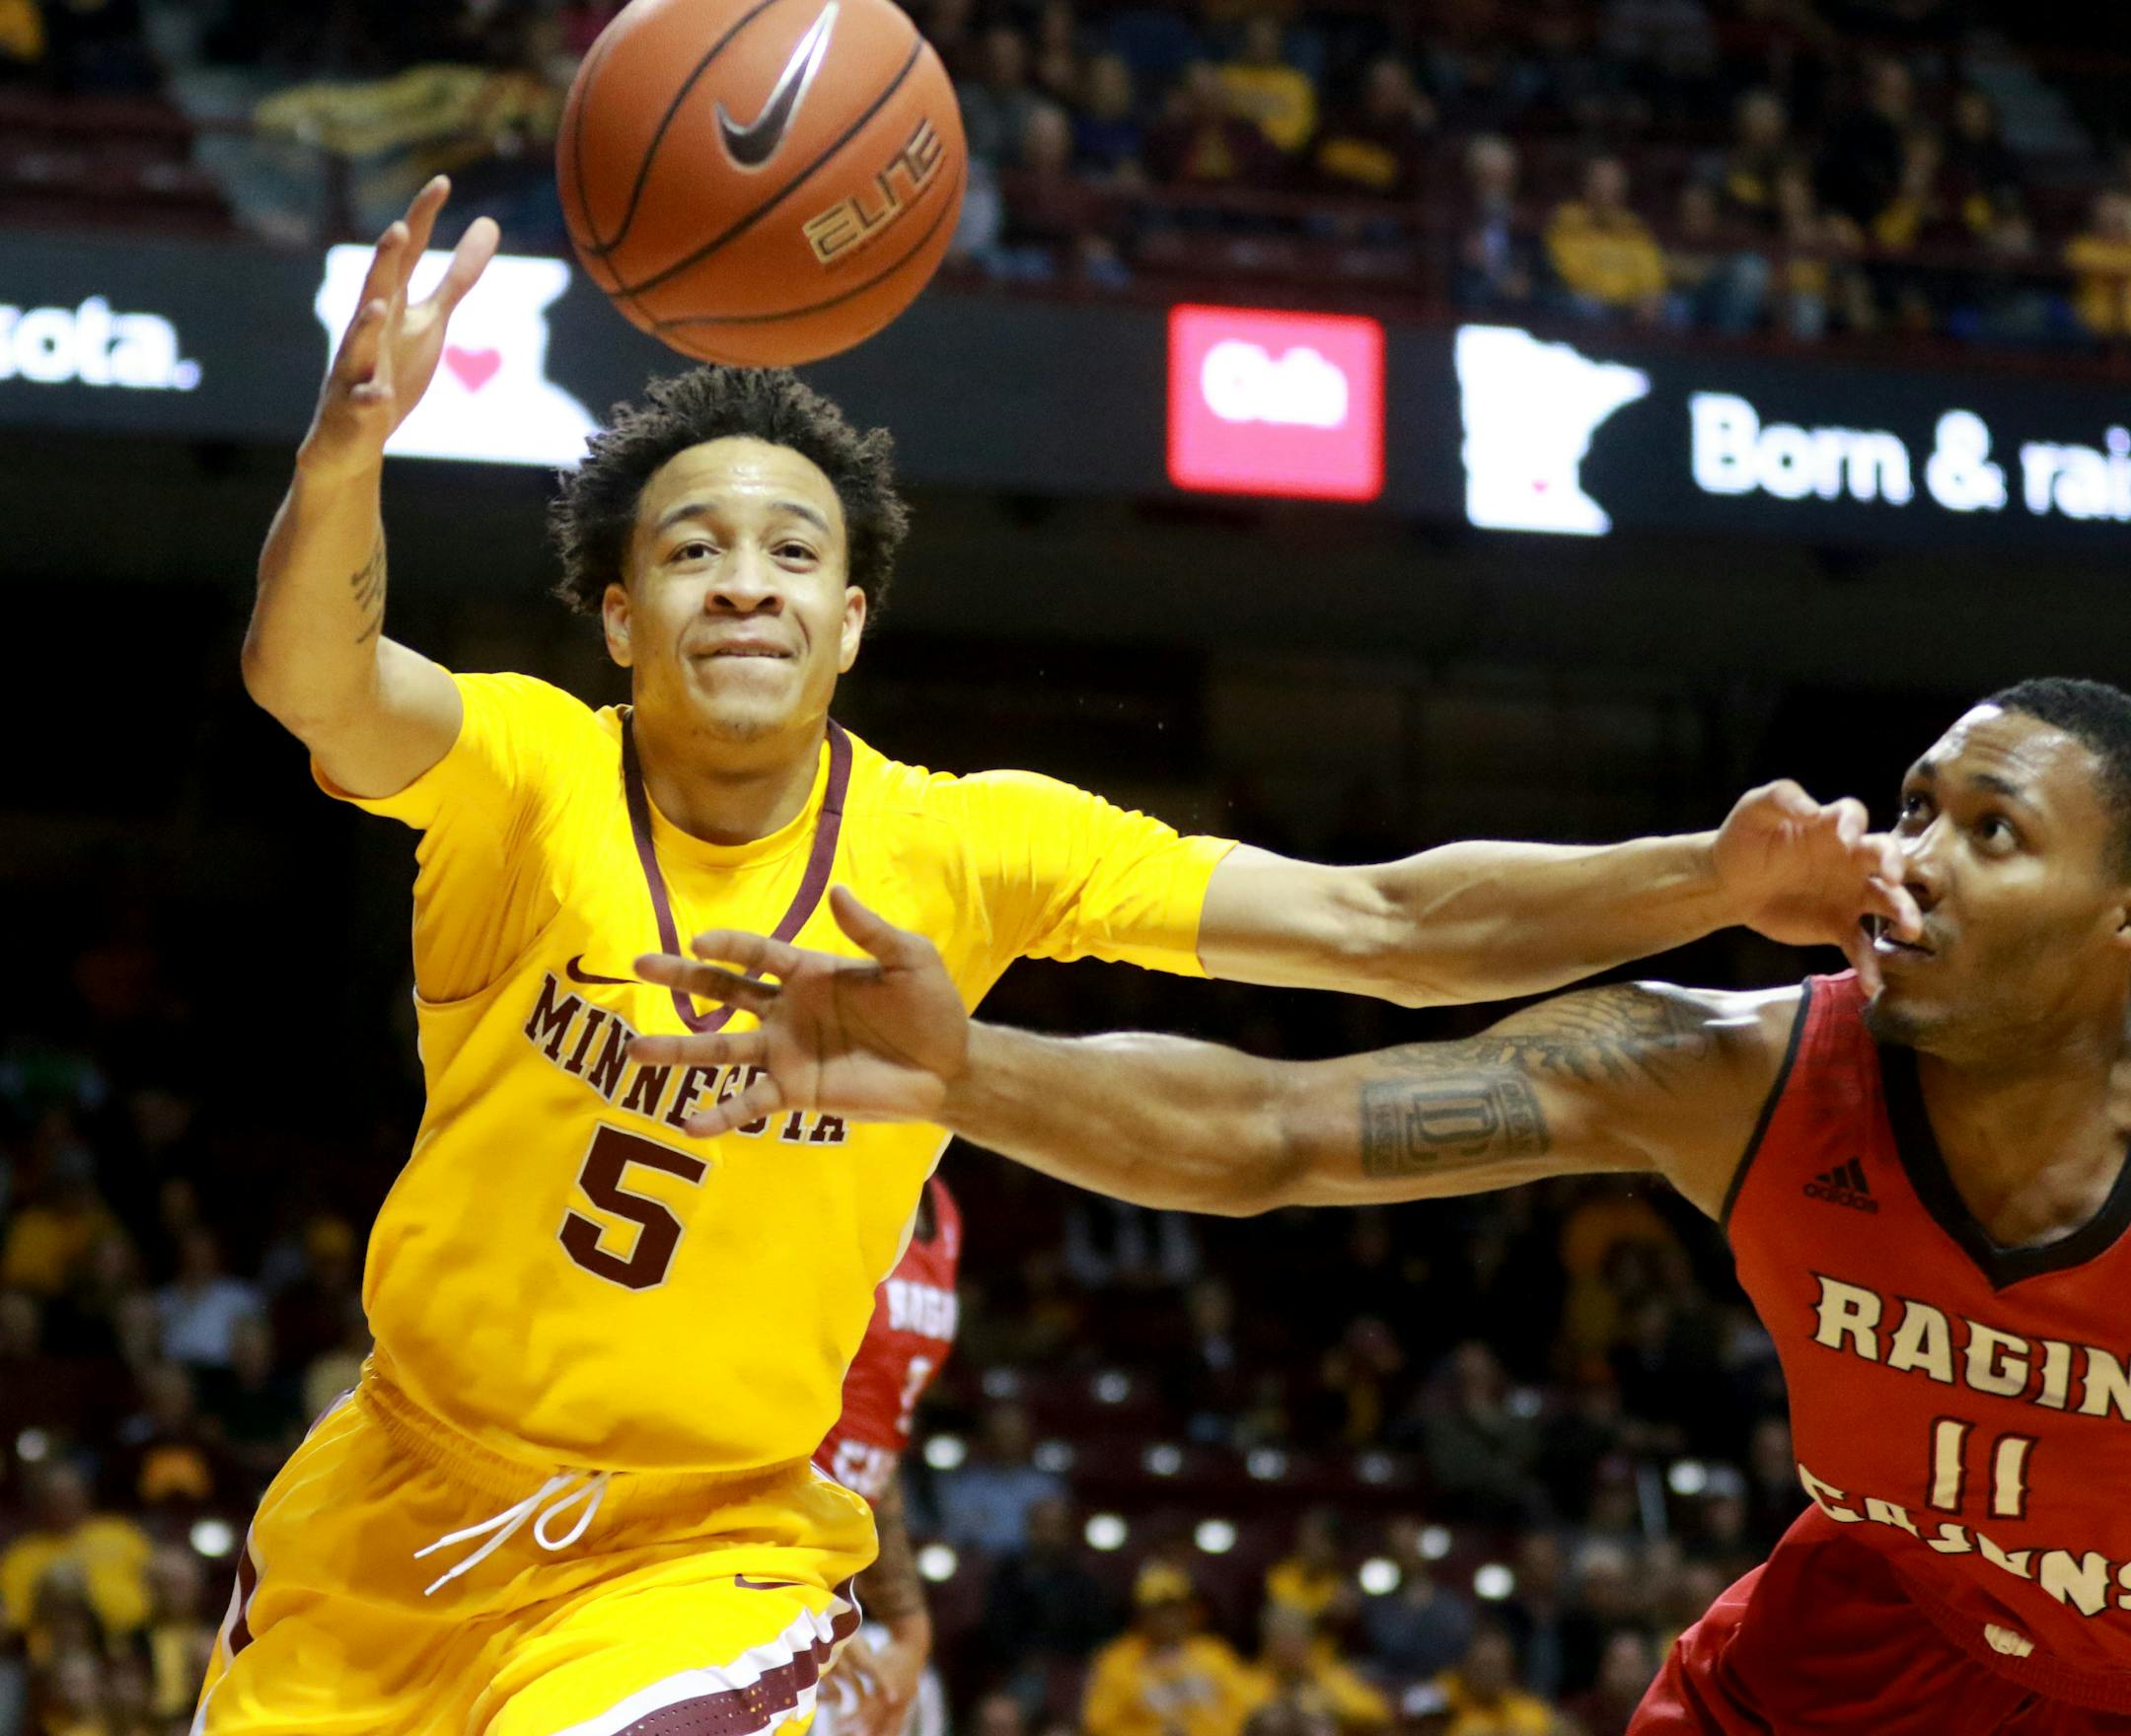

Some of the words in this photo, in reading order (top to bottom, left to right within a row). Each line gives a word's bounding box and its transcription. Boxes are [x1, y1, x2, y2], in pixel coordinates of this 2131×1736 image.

[802, 117, 947, 264] ELITE
[1689, 392, 1914, 505] Born
[1925, 408, 2009, 512] &
[557, 1120, 712, 1292] 5
[1801, 1182, 1879, 1215] adidas
[1808, 1270, 2131, 1421] RAGIN
[1927, 1415, 2038, 1521] 11
